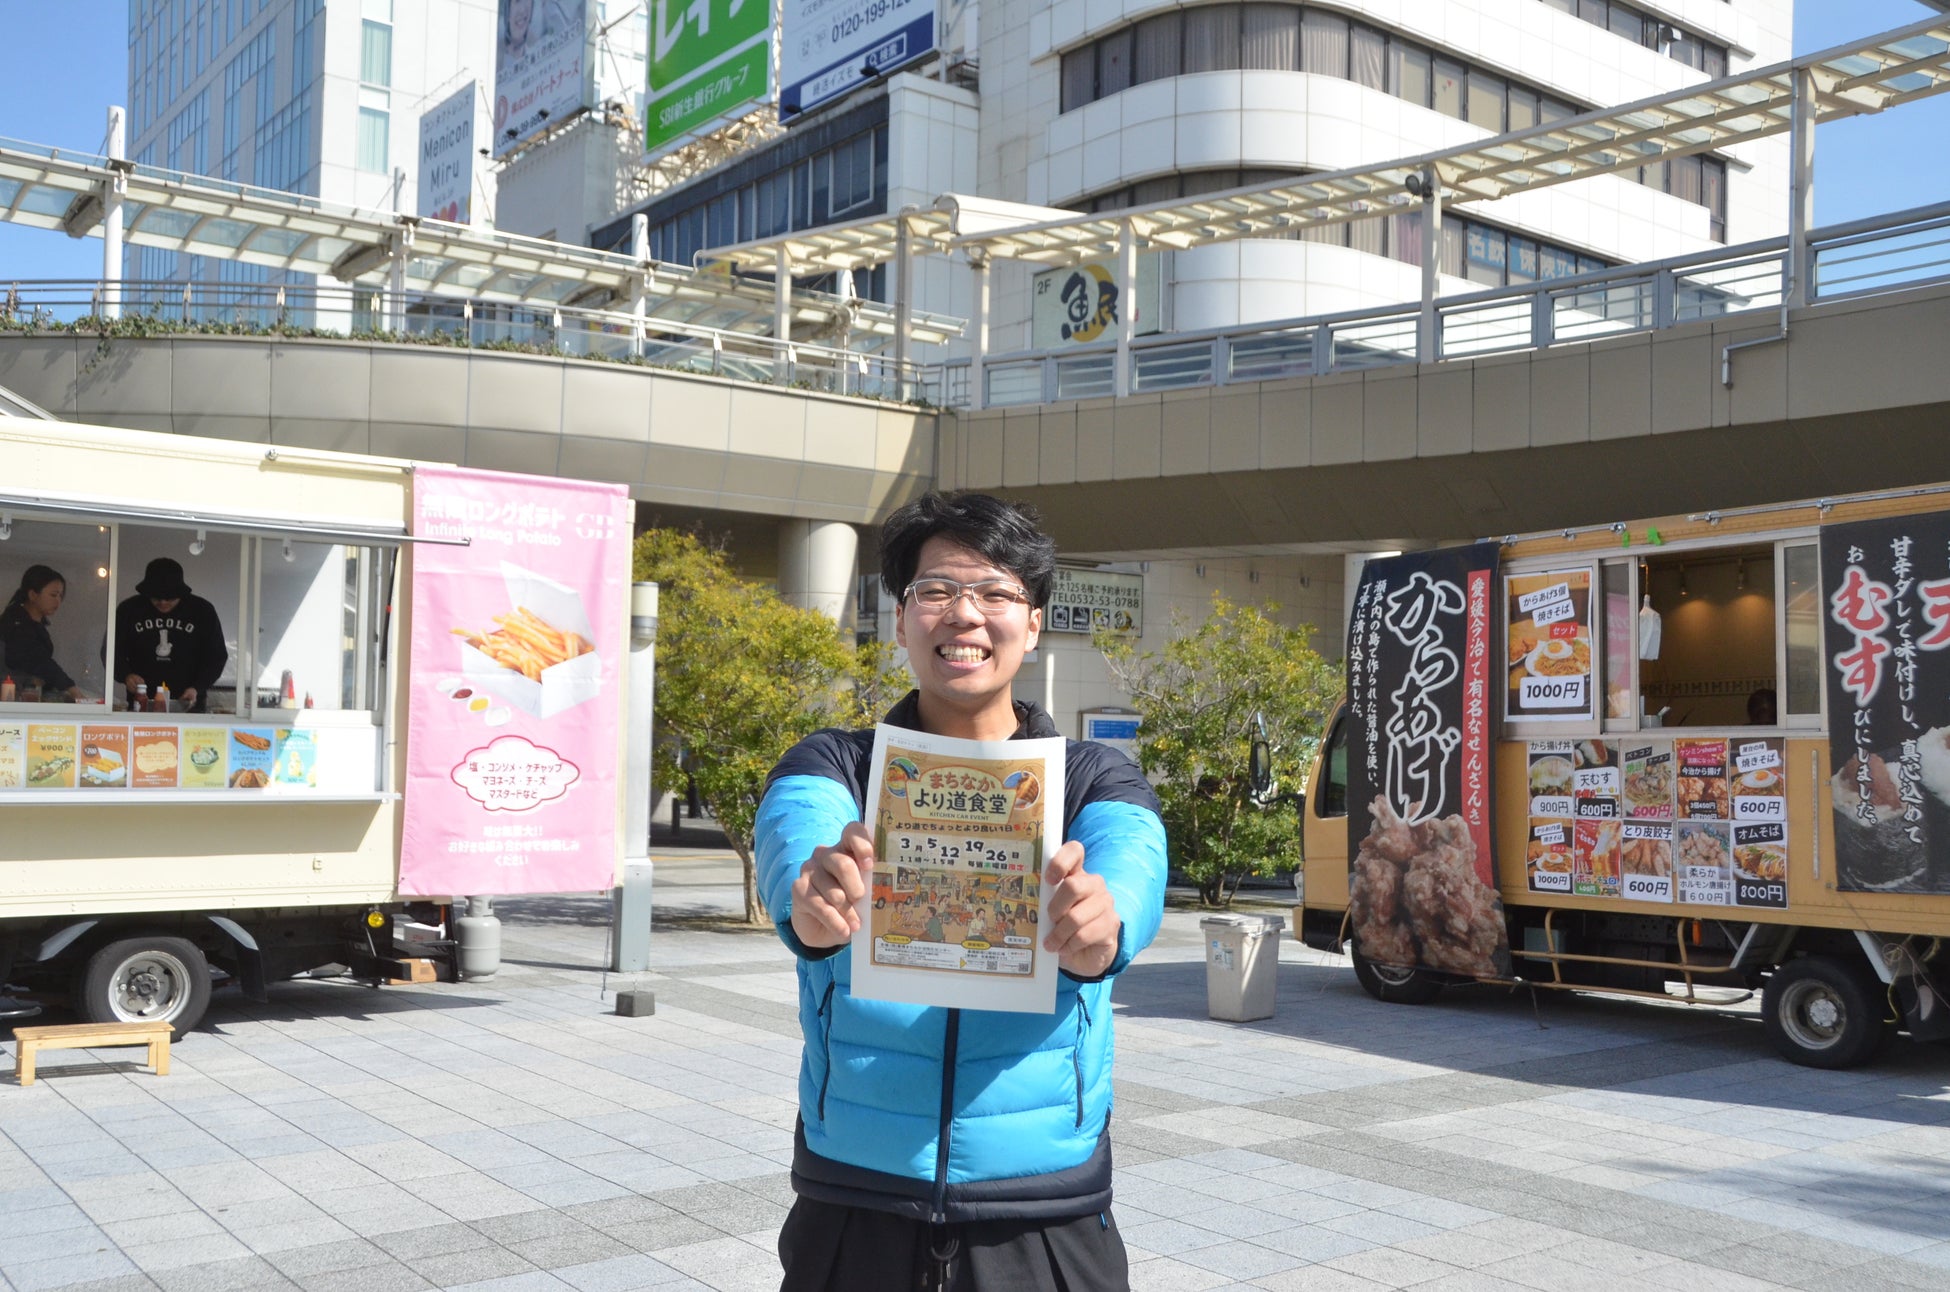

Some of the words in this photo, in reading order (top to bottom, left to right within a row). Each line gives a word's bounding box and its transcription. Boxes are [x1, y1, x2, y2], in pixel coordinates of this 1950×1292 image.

[659, 63, 750, 129] SBI新生銀行グループ
[423, 120, 469, 163] Menicon
[430, 160, 459, 192] Miru
[1037, 279, 1051, 295] 2F
[425, 522, 476, 540] Infinite
[479, 526, 514, 545] Long
[517, 529, 562, 546] Potato
[1523, 585, 1567, 607] からあげ3個
[1537, 604, 1571, 622] 焼きそば
[135, 618, 194, 633] COCOLO
[1553, 626, 1576, 635] セット
[1351, 583, 1373, 718] 丁寧に漬け込みました。
[1526, 682, 1579, 698] 1000円
[1385, 571, 1467, 826] からあげ
[1466, 577, 1486, 826] 愛媛今治で有名なせんざんき
[84, 733, 125, 741] ロングポテト
[1531, 741, 1570, 751] から揚げ丼
[1742, 753, 1775, 768] 焼きそば
[1682, 766, 1721, 776] 今治から揚げ
[930, 772, 995, 793] まちなか
[1580, 772, 1611, 786] 天むす
[914, 789, 1007, 815] より道食堂
[1540, 801, 1569, 814] 900円
[1740, 801, 1780, 815] 600円
[929, 811, 955, 820] KITCHEN
[1581, 804, 1612, 817] 600円
[1625, 826, 1672, 838] とり皮餃子
[1738, 827, 1780, 840] オムそば
[901, 838, 910, 849] 3
[927, 838, 938, 849] 5
[941, 846, 960, 858] 12
[965, 841, 984, 852] 19
[986, 851, 1007, 862] 26
[1538, 875, 1567, 885] 1000円
[1689, 868, 1716, 878] 柔らか
[1629, 881, 1668, 895] 600円
[1680, 880, 1731, 889] ホルモン唐揚げ
[1740, 885, 1783, 900] 800円
